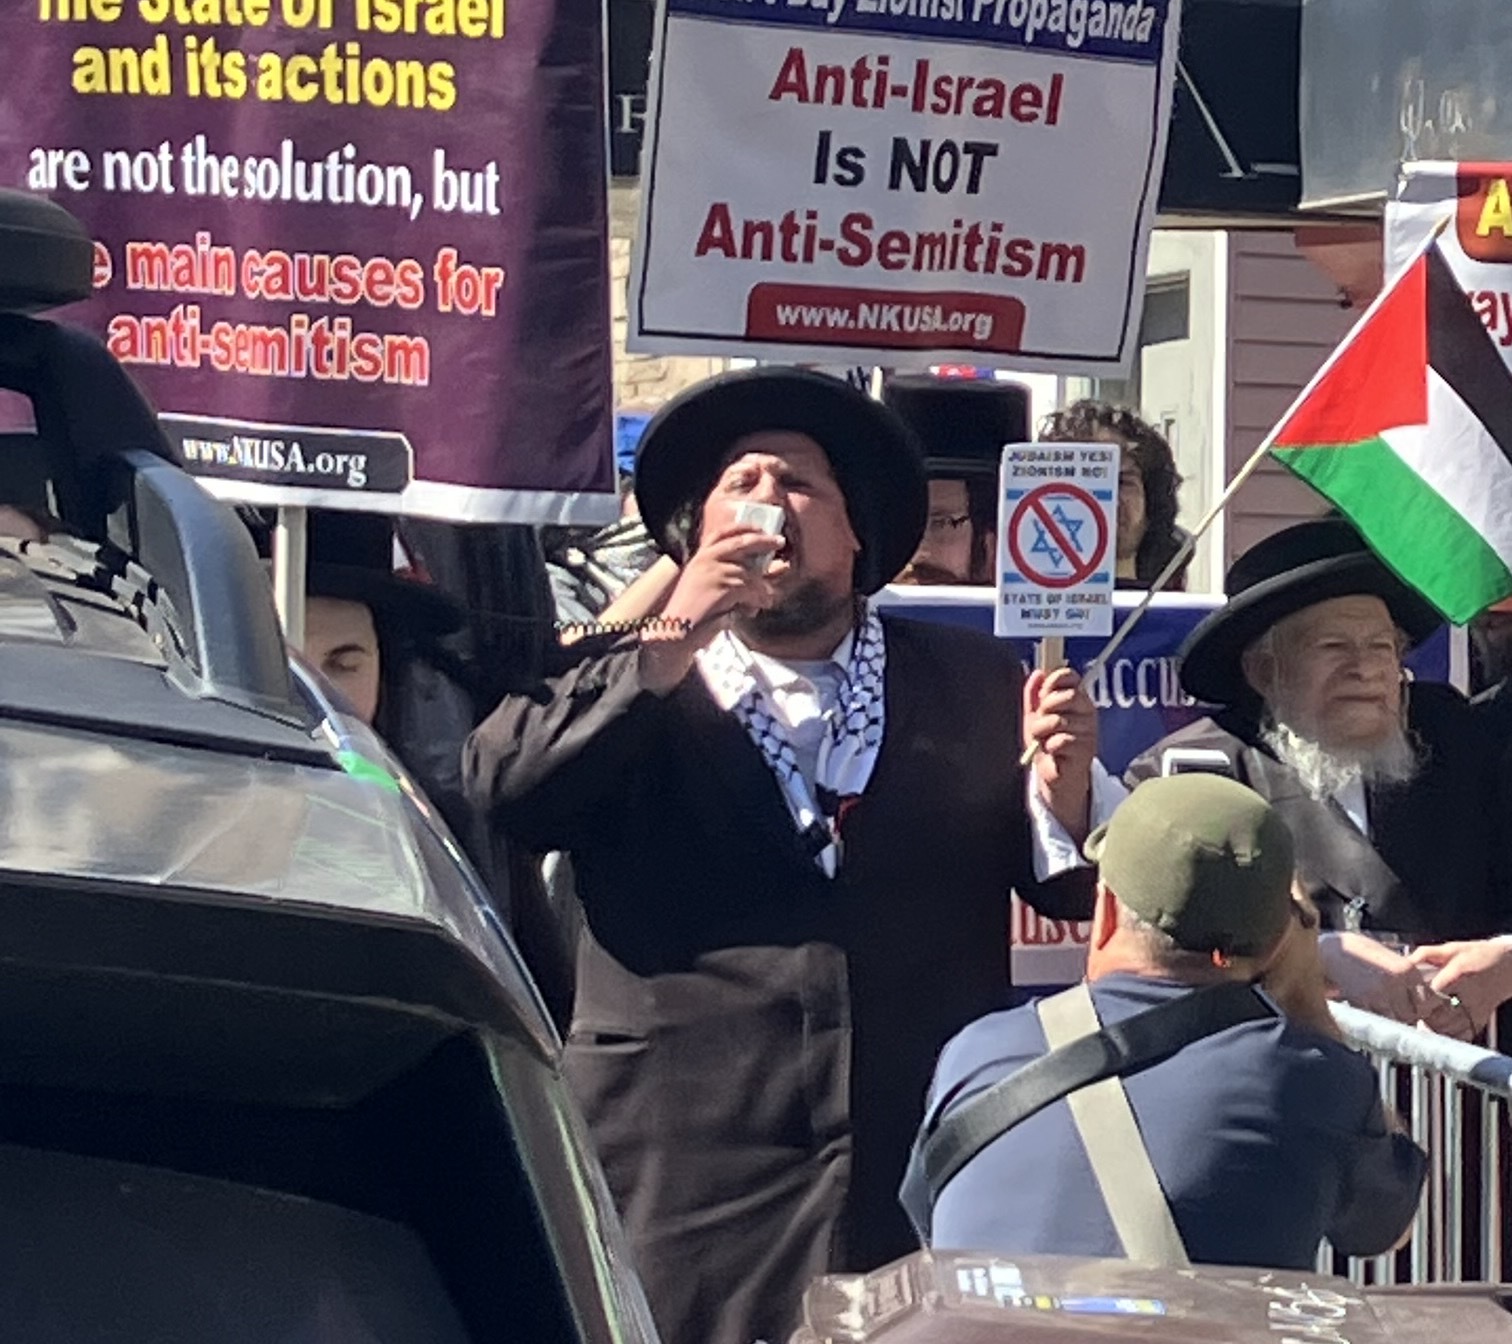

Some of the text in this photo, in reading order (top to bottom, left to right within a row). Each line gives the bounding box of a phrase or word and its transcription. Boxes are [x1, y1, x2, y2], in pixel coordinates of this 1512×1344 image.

[72, 33, 458, 111] and its actions
[768, 46, 1066, 127] Anti-Israel
[28, 145, 90, 191] are
[102, 139, 175, 193] not
[433, 148, 500, 217] but
[812, 129, 1000, 196] Is NOT
[125, 230, 234, 297] main
[241, 248, 425, 313] causes
[433, 243, 506, 318] for
[694, 201, 1087, 285] Anti-Semitism
[105, 303, 431, 388] anti-semitism
